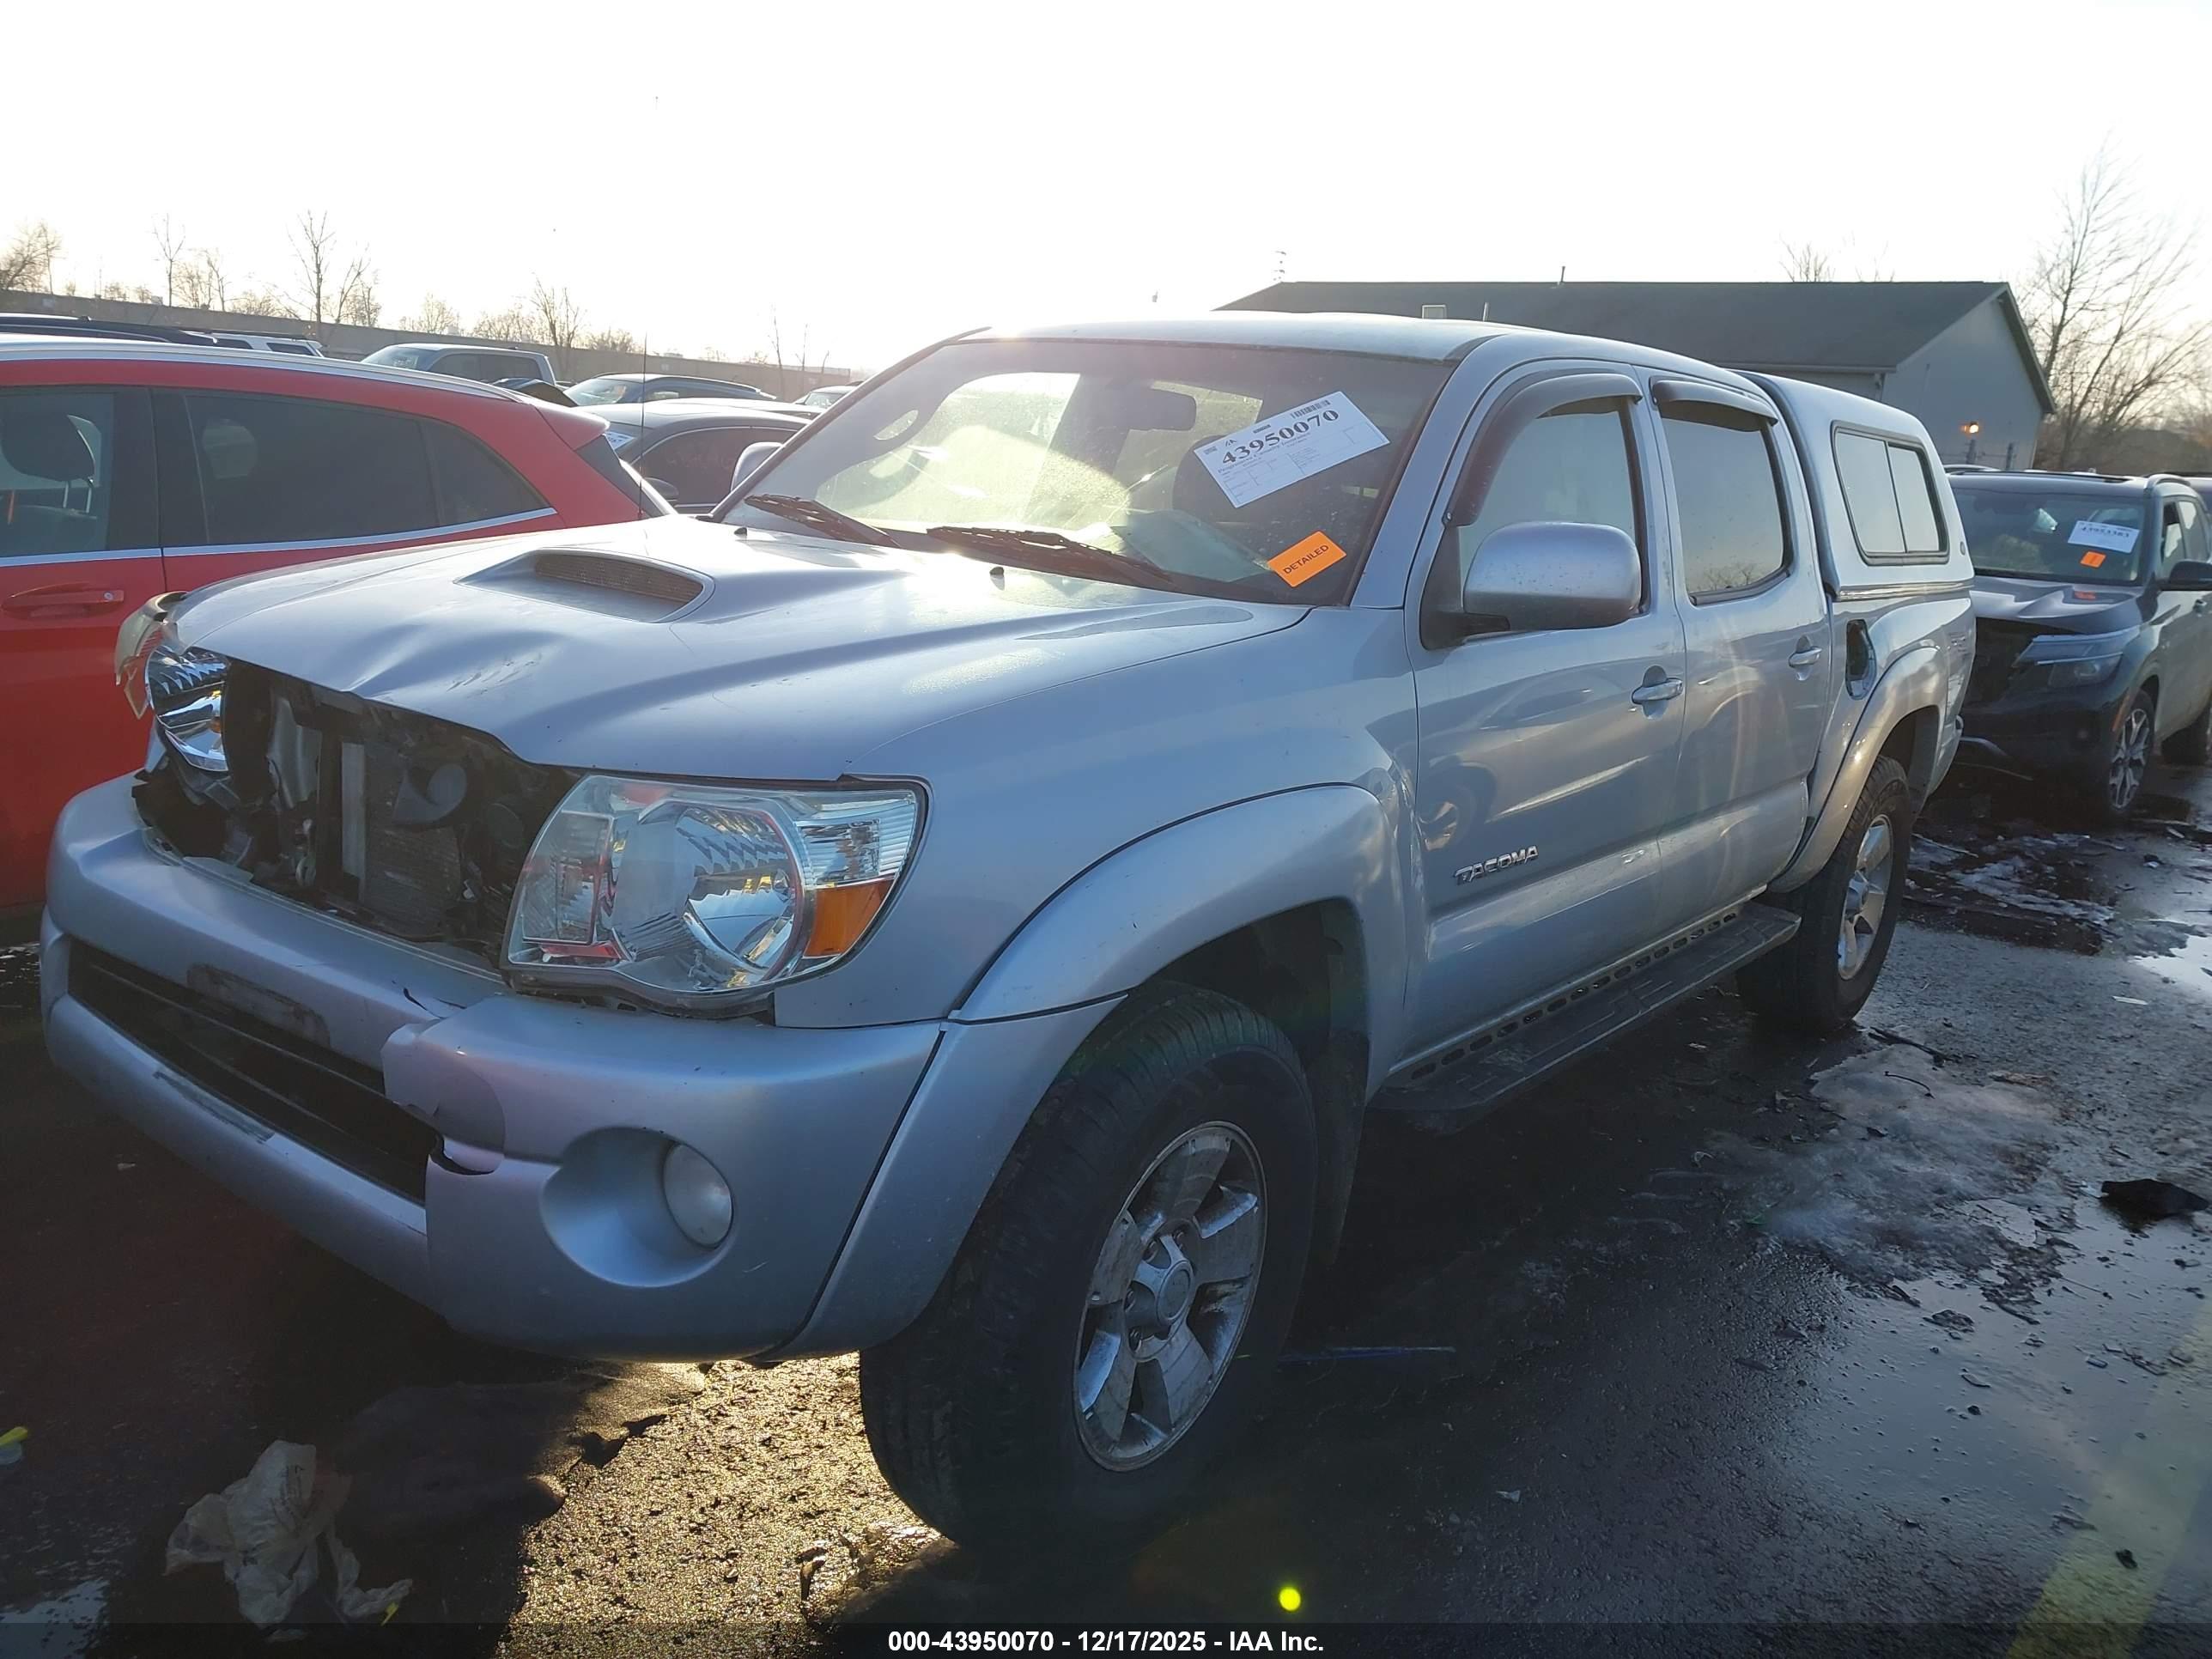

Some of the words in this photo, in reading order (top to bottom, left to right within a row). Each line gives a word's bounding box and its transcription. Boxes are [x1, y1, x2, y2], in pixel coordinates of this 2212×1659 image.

[1222, 410, 1340, 464] 43950070
[1283, 544, 1329, 574] DETAILED
[1454, 845, 1539, 884] TACOMA
